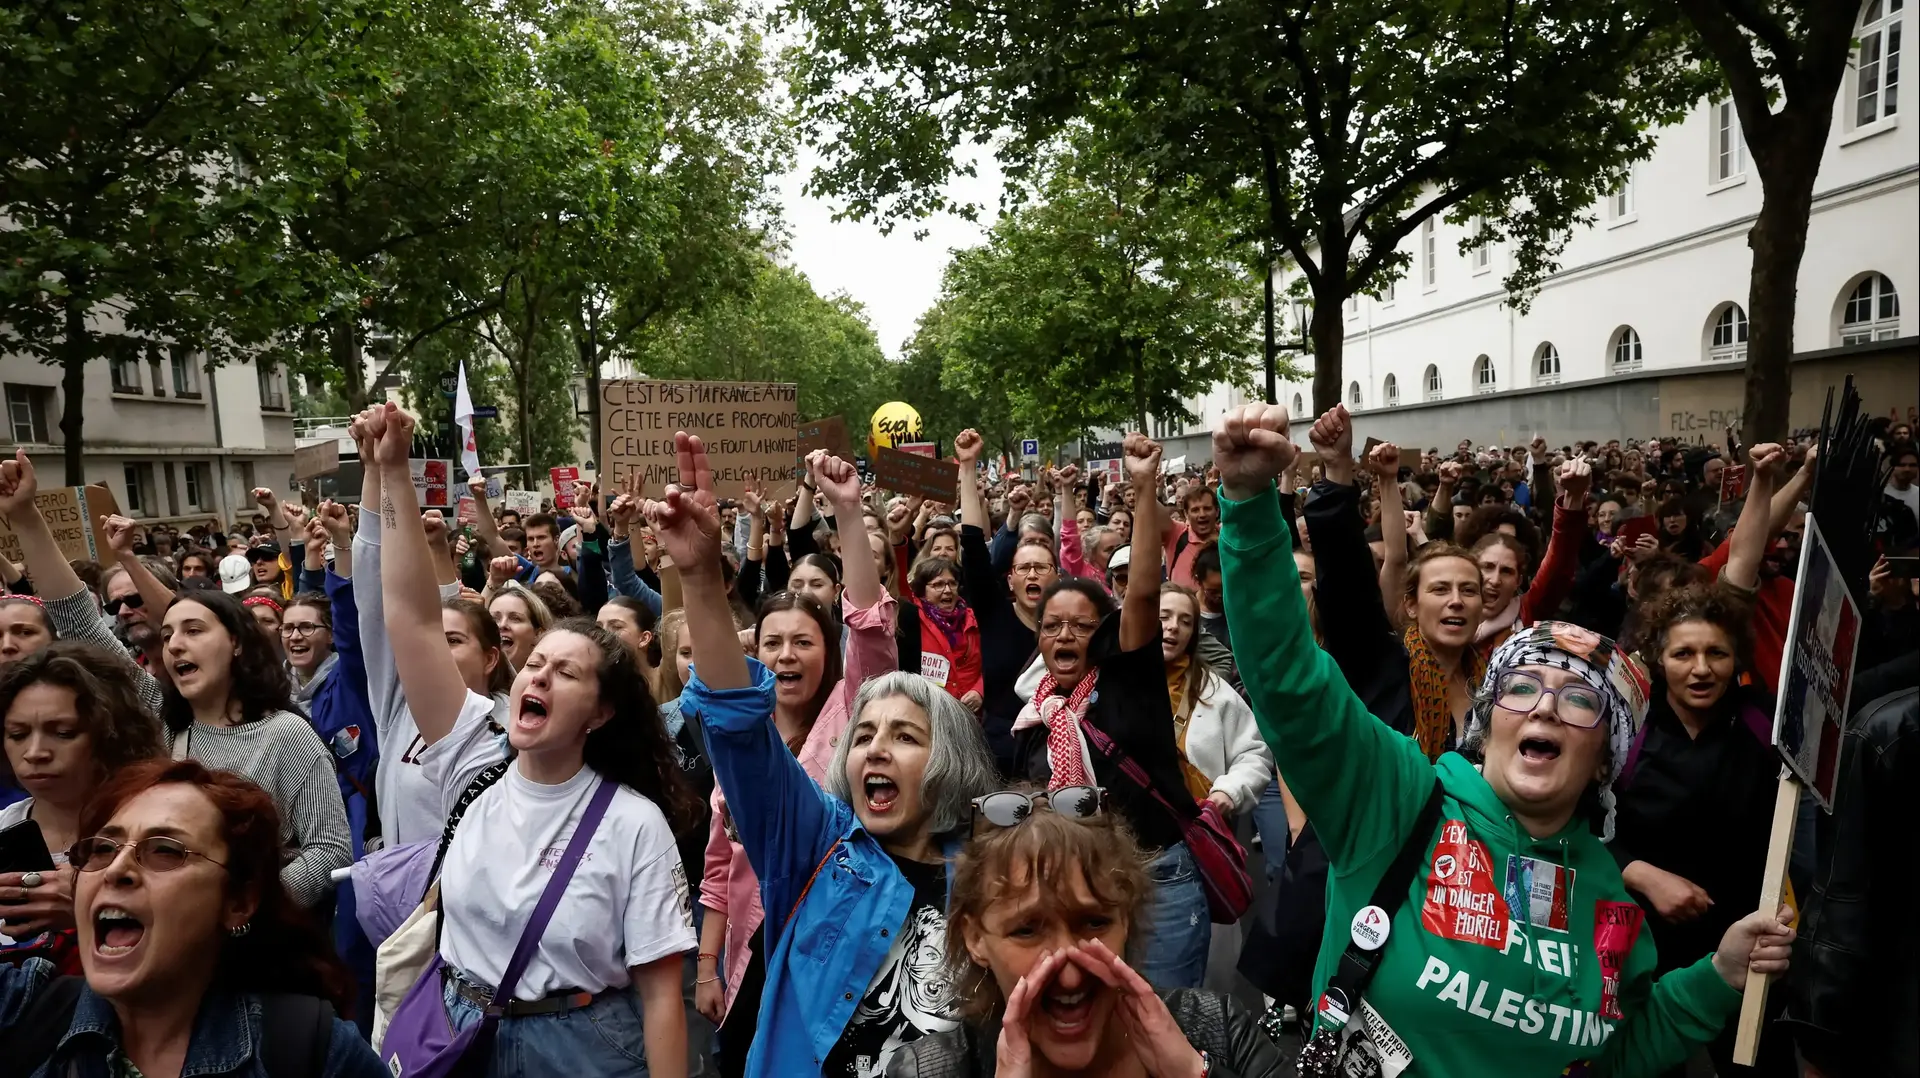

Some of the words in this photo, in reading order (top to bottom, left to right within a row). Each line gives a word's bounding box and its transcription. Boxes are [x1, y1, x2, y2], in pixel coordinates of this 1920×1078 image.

[441, 377, 457, 387] BUS
[603, 379, 654, 406] C'EST
[659, 383, 684, 404] PAS
[608, 408, 662, 432] CETTE
[667, 411, 725, 429] FRANCE
[732, 410, 797, 430] PROFONDE
[610, 435, 659, 457] CELLE
[663, 439, 678, 457] QU
[720, 438, 748, 454] FOUT
[749, 439, 763, 453] LA
[764, 437, 796, 454] HONTE
[1026, 443, 1034, 454] P
[612, 461, 641, 484] ET
[710, 467, 734, 487] QUE
[760, 466, 796, 481] PLONGE
[35, 492, 68, 508] ERRO
[921, 655, 944, 669] RONT
[1458, 870, 1474, 887] EST
[1432, 885, 1448, 904] UN
[1449, 889, 1495, 915] DANGER
[1352, 926, 1379, 946] PALESTINE
[1356, 920, 1381, 940] URGENCE
[1455, 911, 1502, 941] MORTEL
[1324, 994, 1345, 1011] PALESTINE
[1360, 1003, 1390, 1038] 'EXTREME
[1387, 1032, 1412, 1061] DROITE
[1362, 1020, 1377, 1041] OUS
[1374, 1032, 1397, 1058] PARLE
